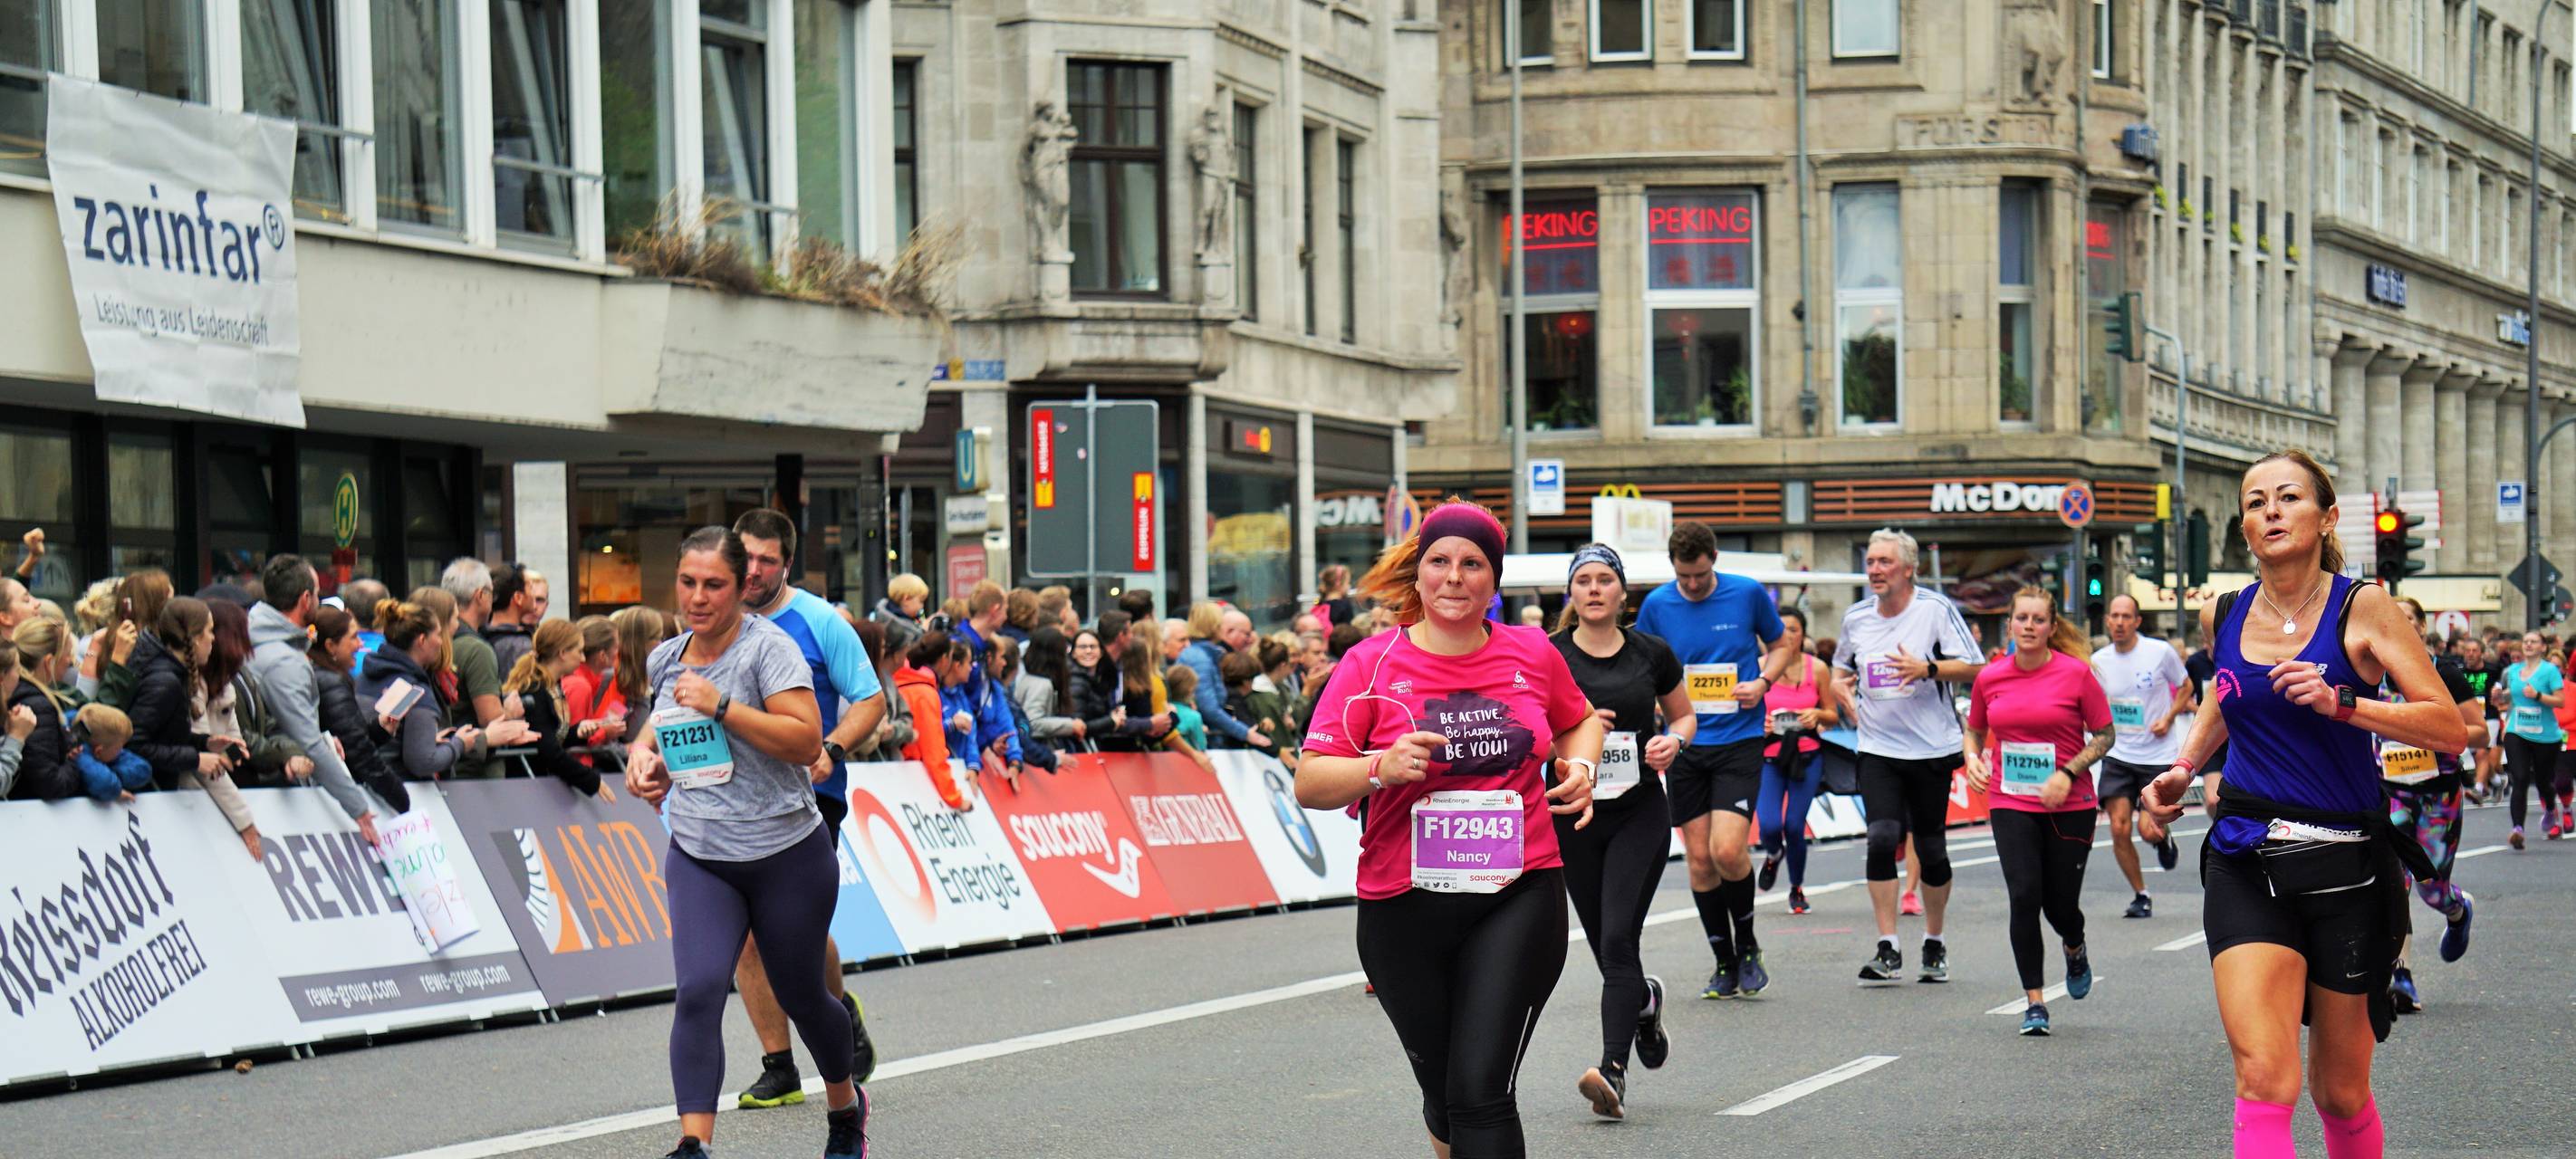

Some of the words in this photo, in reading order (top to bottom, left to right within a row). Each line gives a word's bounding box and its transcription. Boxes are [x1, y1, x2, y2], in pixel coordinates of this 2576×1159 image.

[1649, 206, 1751, 233] PEKING
[93, 292, 159, 338] Leistung
[159, 309, 186, 333] aus
[188, 305, 270, 348] Leidenschaft
[957, 437, 974, 482] U
[1930, 482, 2062, 512] McDon
[1693, 676, 1729, 688] 22751
[1439, 713, 1456, 724] BE
[1458, 708, 1503, 723] ACTIVE.
[661, 723, 716, 749] F21231
[1445, 725, 1461, 739] Be
[1463, 724, 1504, 741] happy.
[678, 752, 708, 765] Liliana
[1445, 743, 1465, 761] BE
[1469, 738, 1508, 757] YOU!
[1601, 748, 1631, 764] 958
[2005, 754, 2050, 769] F12794
[901, 800, 976, 849] Rhein
[1424, 816, 1514, 839] F12943
[1009, 810, 1116, 866] saucony
[1447, 849, 1492, 865] Nancy
[261, 831, 408, 922] REWE
[929, 852, 1021, 911] Energie
[1469, 874, 1507, 883] saucony
[69, 918, 207, 1052] ALKOHOLFREI
[420, 963, 511, 994] rewe-group.com
[304, 978, 401, 1009] rewe-group.com
